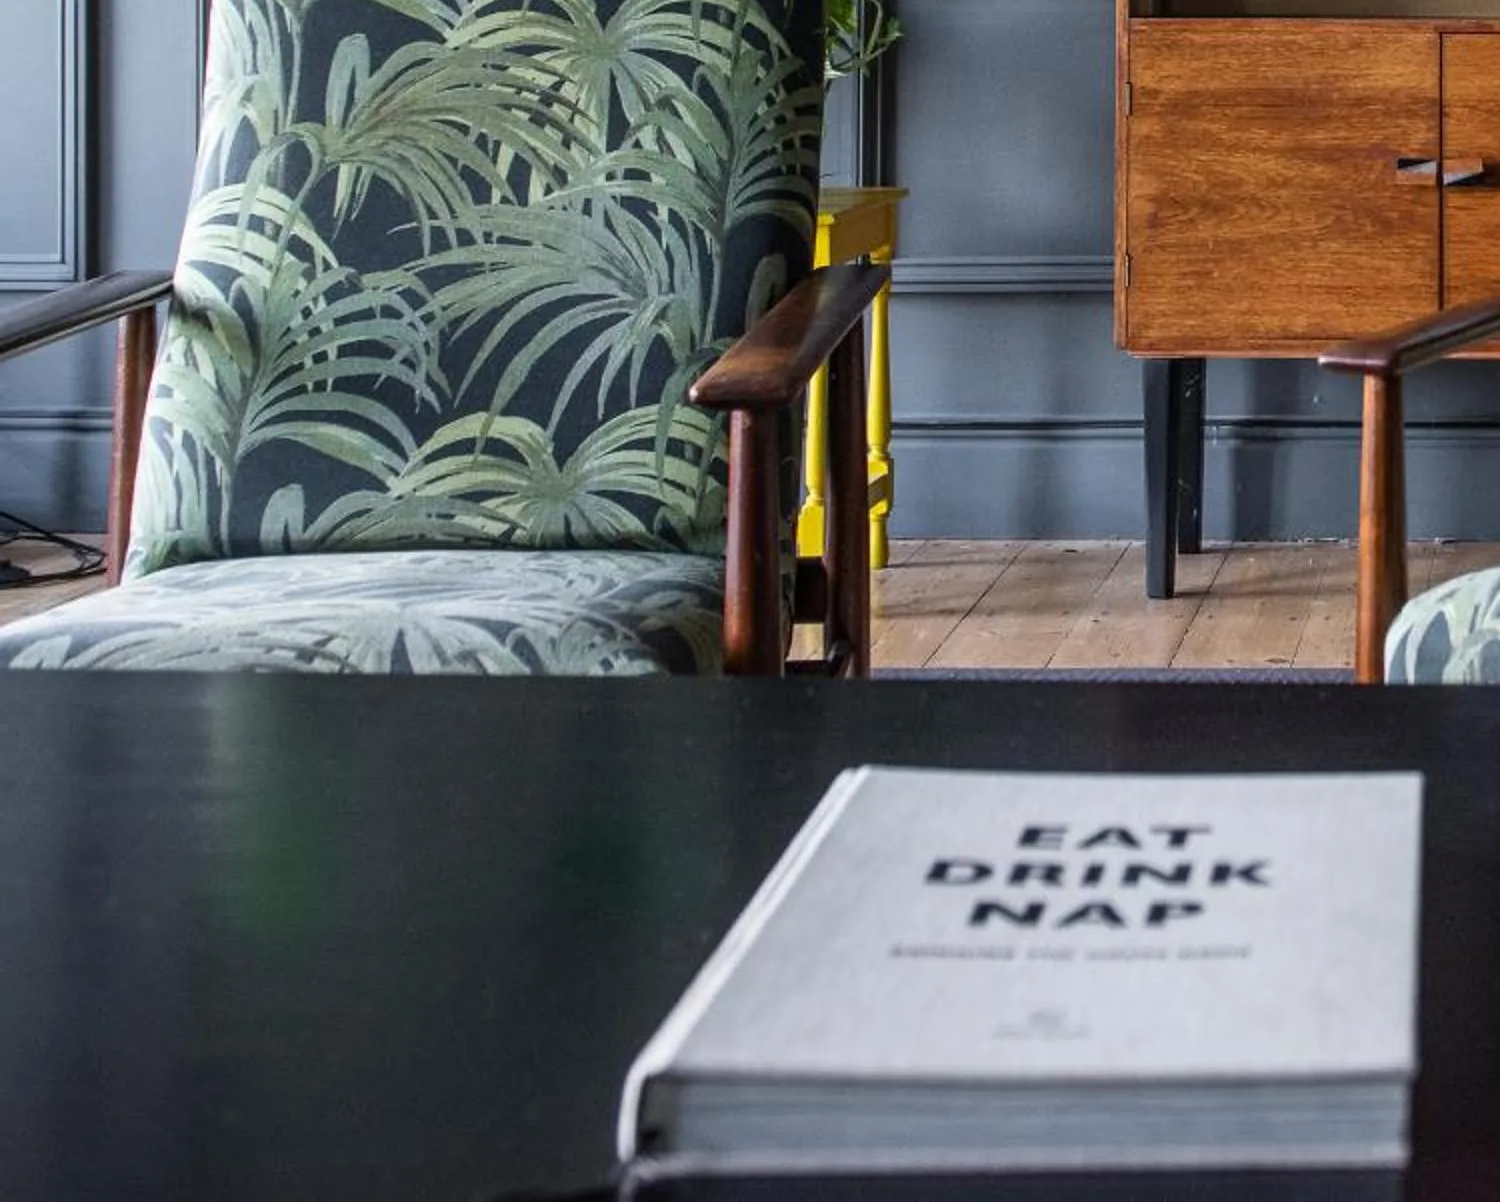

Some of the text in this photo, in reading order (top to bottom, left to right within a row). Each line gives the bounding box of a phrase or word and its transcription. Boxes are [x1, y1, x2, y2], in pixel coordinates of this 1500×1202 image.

[1015, 824, 1212, 850] EAT
[924, 857, 1271, 888] DRINK
[966, 899, 1205, 929] NAP
